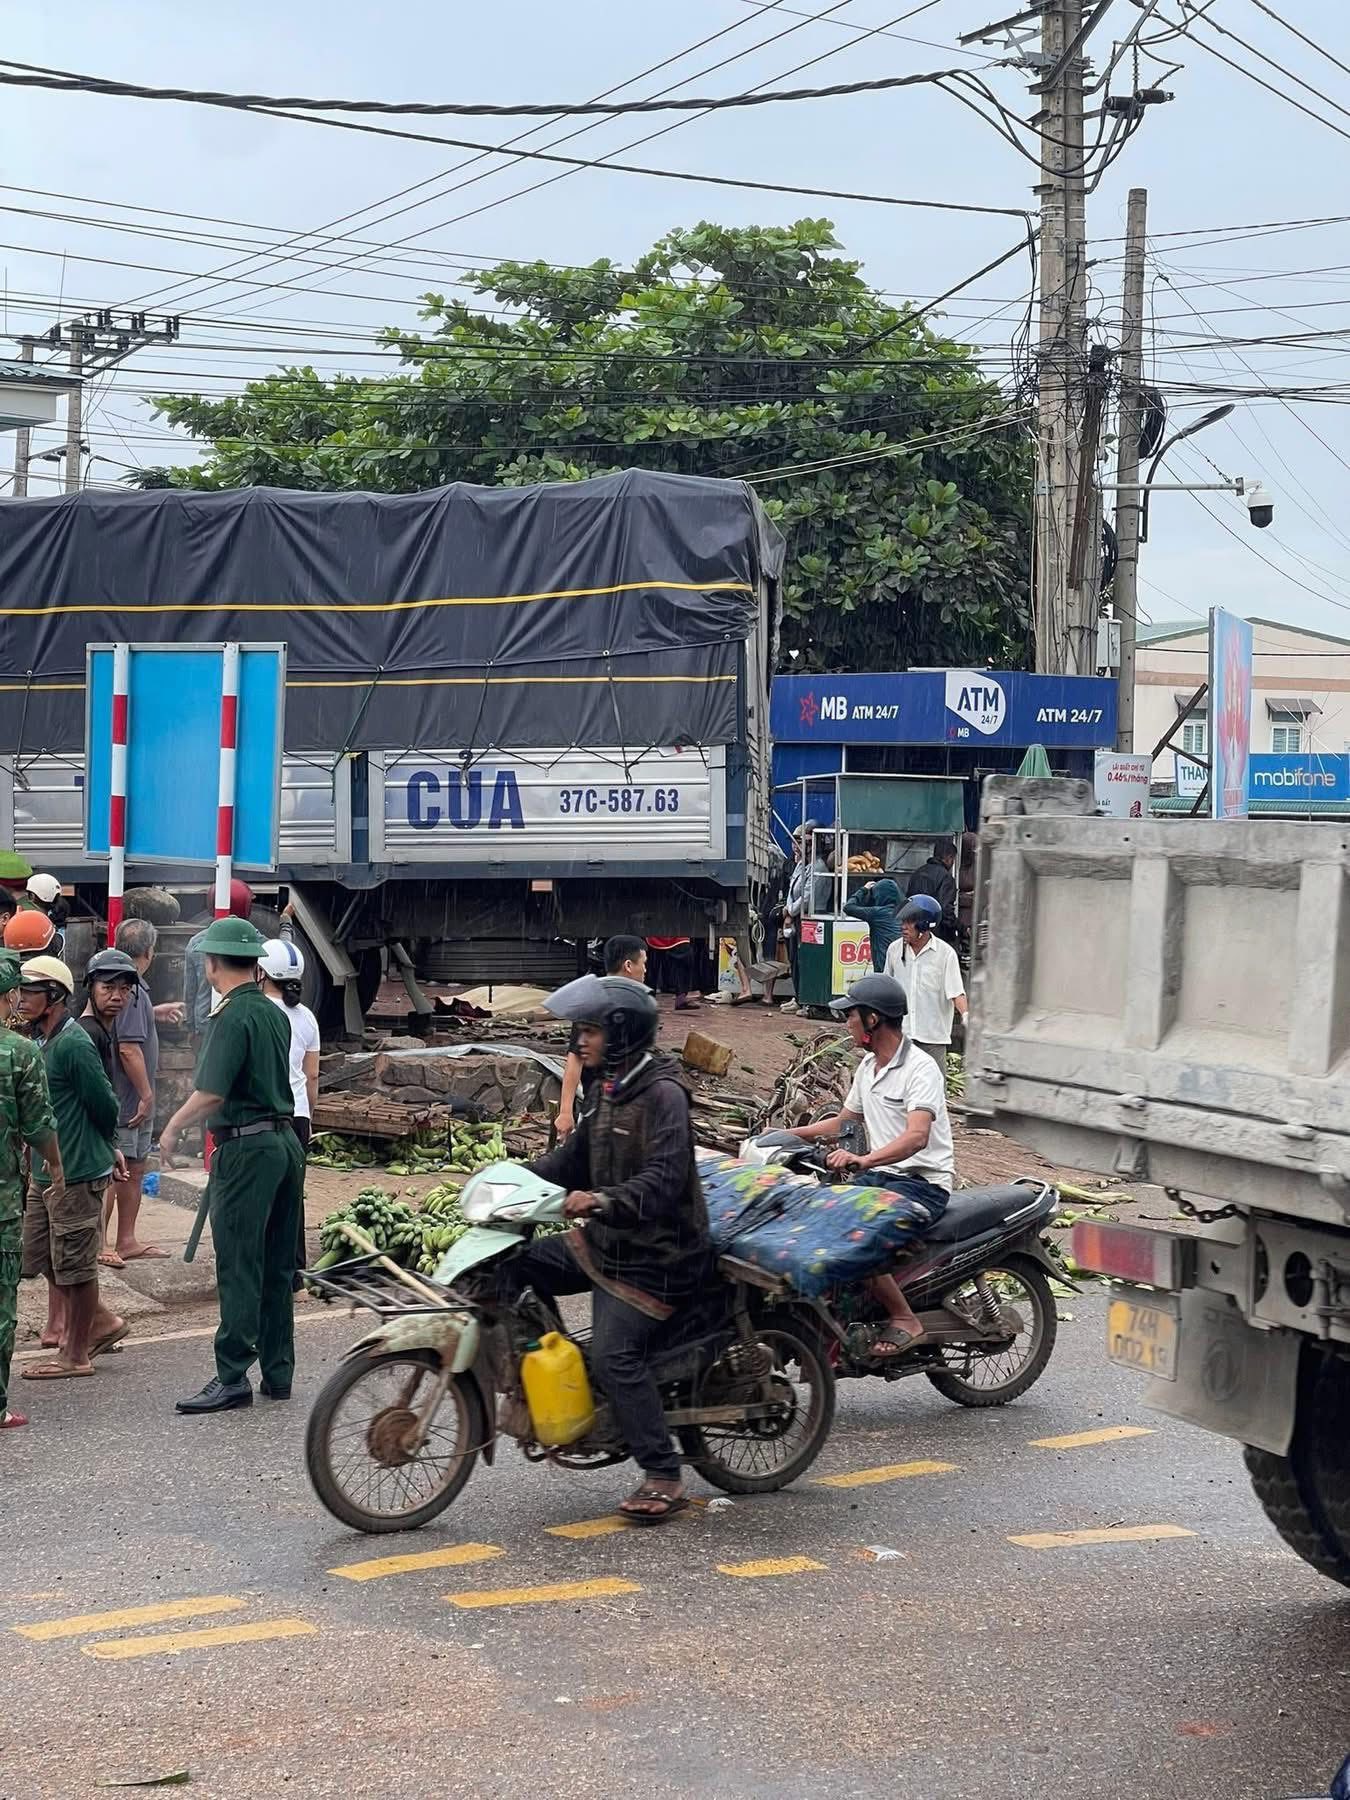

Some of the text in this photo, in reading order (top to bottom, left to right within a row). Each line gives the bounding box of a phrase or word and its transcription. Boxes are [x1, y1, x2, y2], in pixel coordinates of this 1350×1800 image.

[820, 696, 899, 720] MB ATM 24/7
[957, 687, 999, 712] ATM
[981, 714, 998, 725] 24/7
[1036, 708, 1103, 723] ATM 24/7
[957, 727, 970, 738] MB
[1254, 767, 1336, 787] mobifone
[559, 788, 679, 813] 37C-587.63
